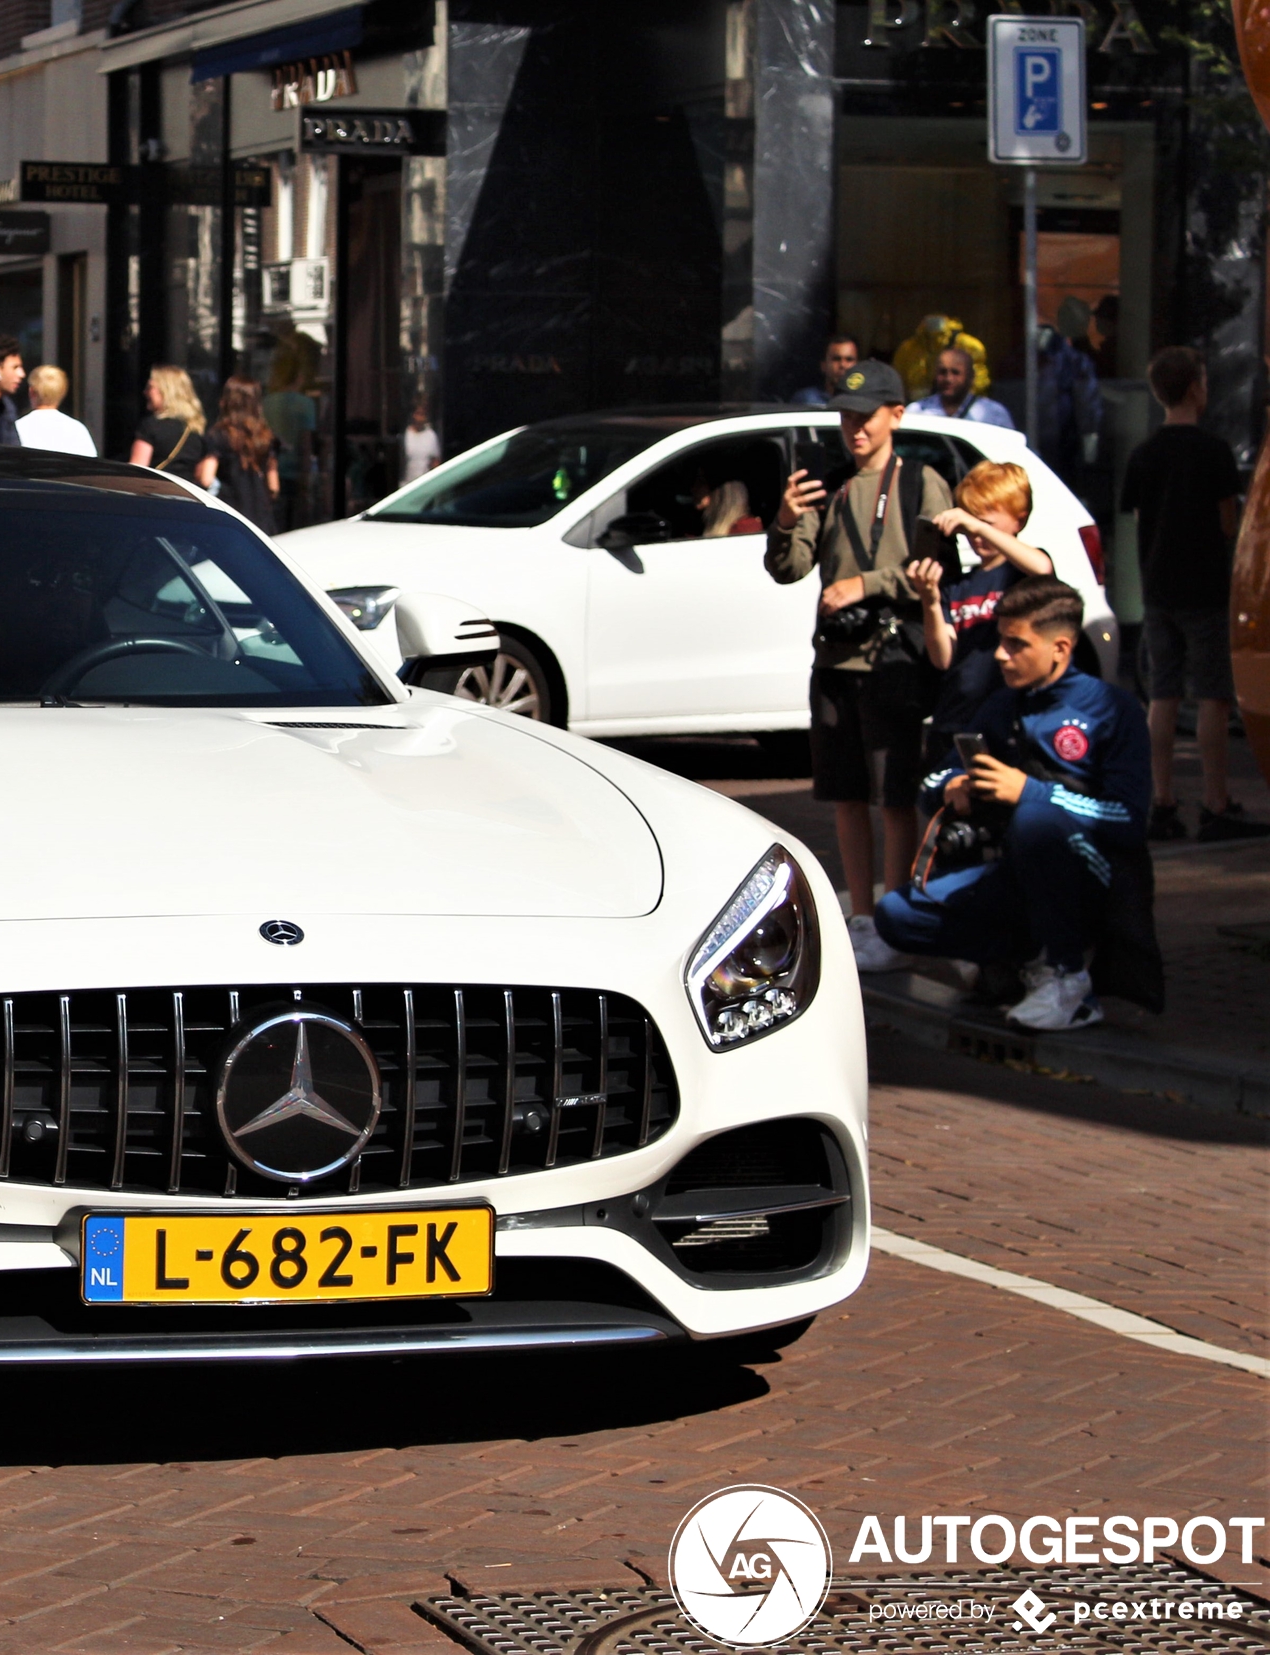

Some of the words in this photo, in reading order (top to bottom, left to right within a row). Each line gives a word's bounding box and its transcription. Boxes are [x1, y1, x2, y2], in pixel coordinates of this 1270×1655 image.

[860, 0, 1155, 52] PRA
[1017, 28, 1058, 42] ZONE
[1024, 55, 1052, 99] P
[303, 117, 415, 144] PRADA
[26, 165, 121, 183] PRESTIGE
[45, 185, 101, 199] HOTEL
[950, 598, 998, 623] Levi
[156, 1222, 461, 1290] L-682-FK
[91, 1269, 118, 1287] NL
